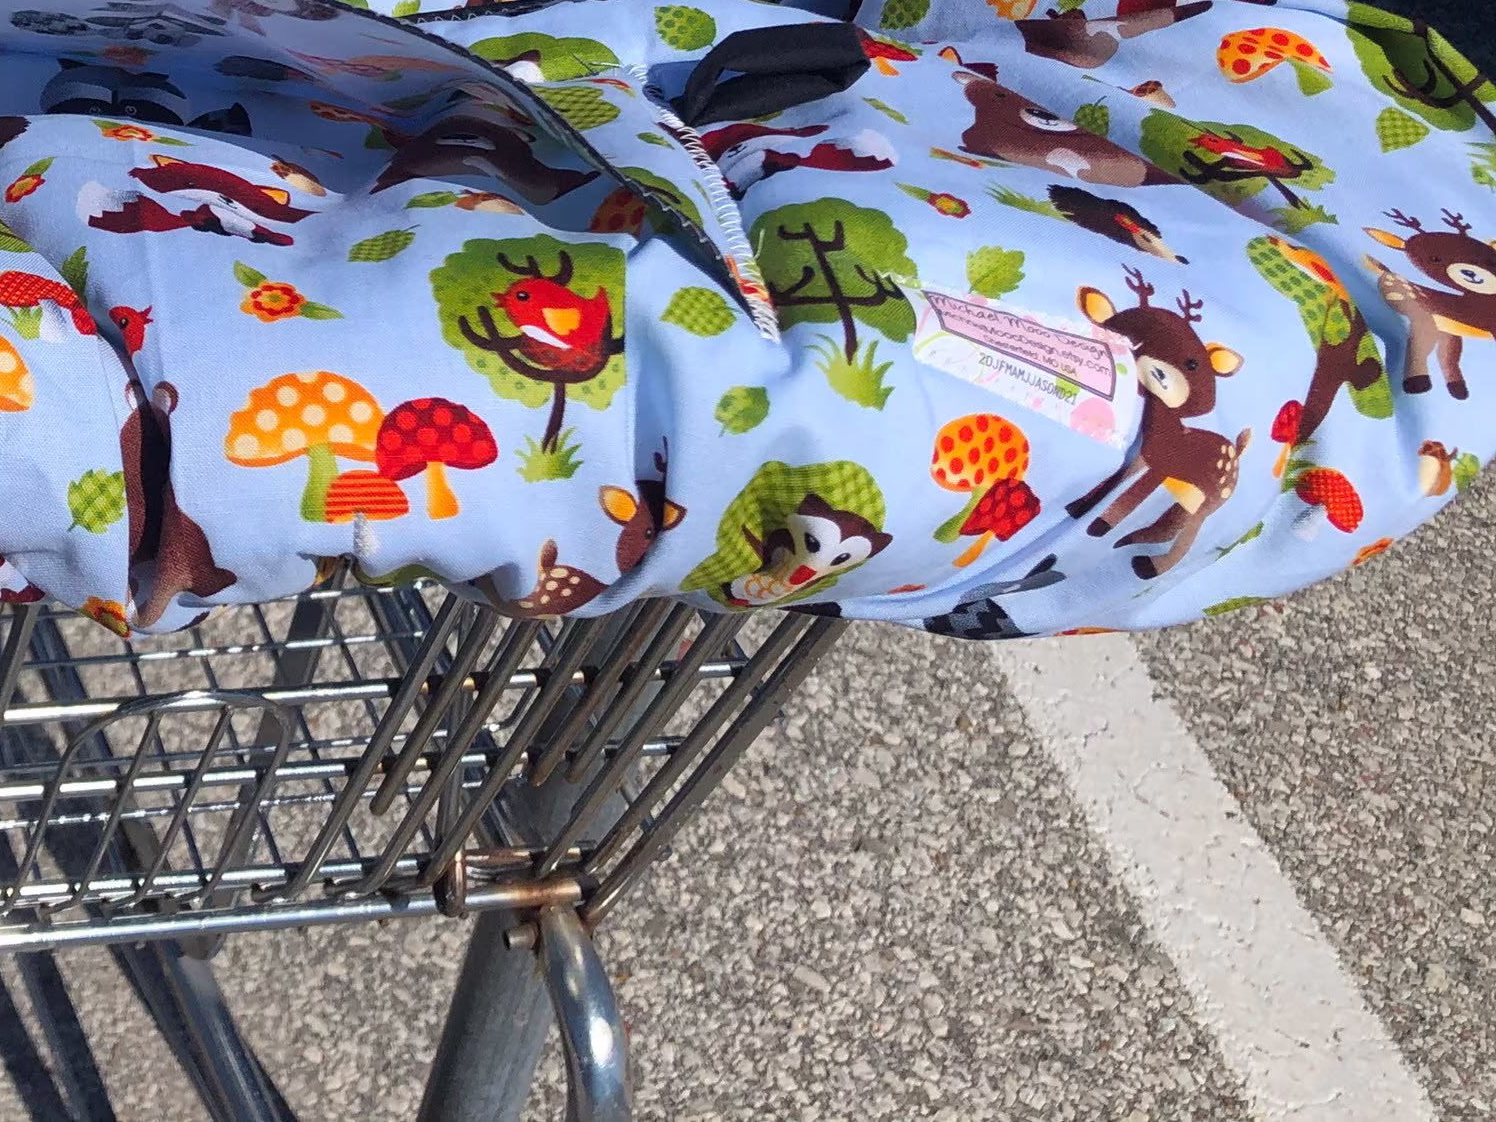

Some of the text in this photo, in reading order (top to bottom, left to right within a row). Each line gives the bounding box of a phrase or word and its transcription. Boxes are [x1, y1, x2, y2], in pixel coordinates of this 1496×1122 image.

[929, 294, 1002, 324] Michael
[1055, 334, 1111, 361] Design
[1042, 354, 1059, 368] MO
[1060, 363, 1077, 377] USA
